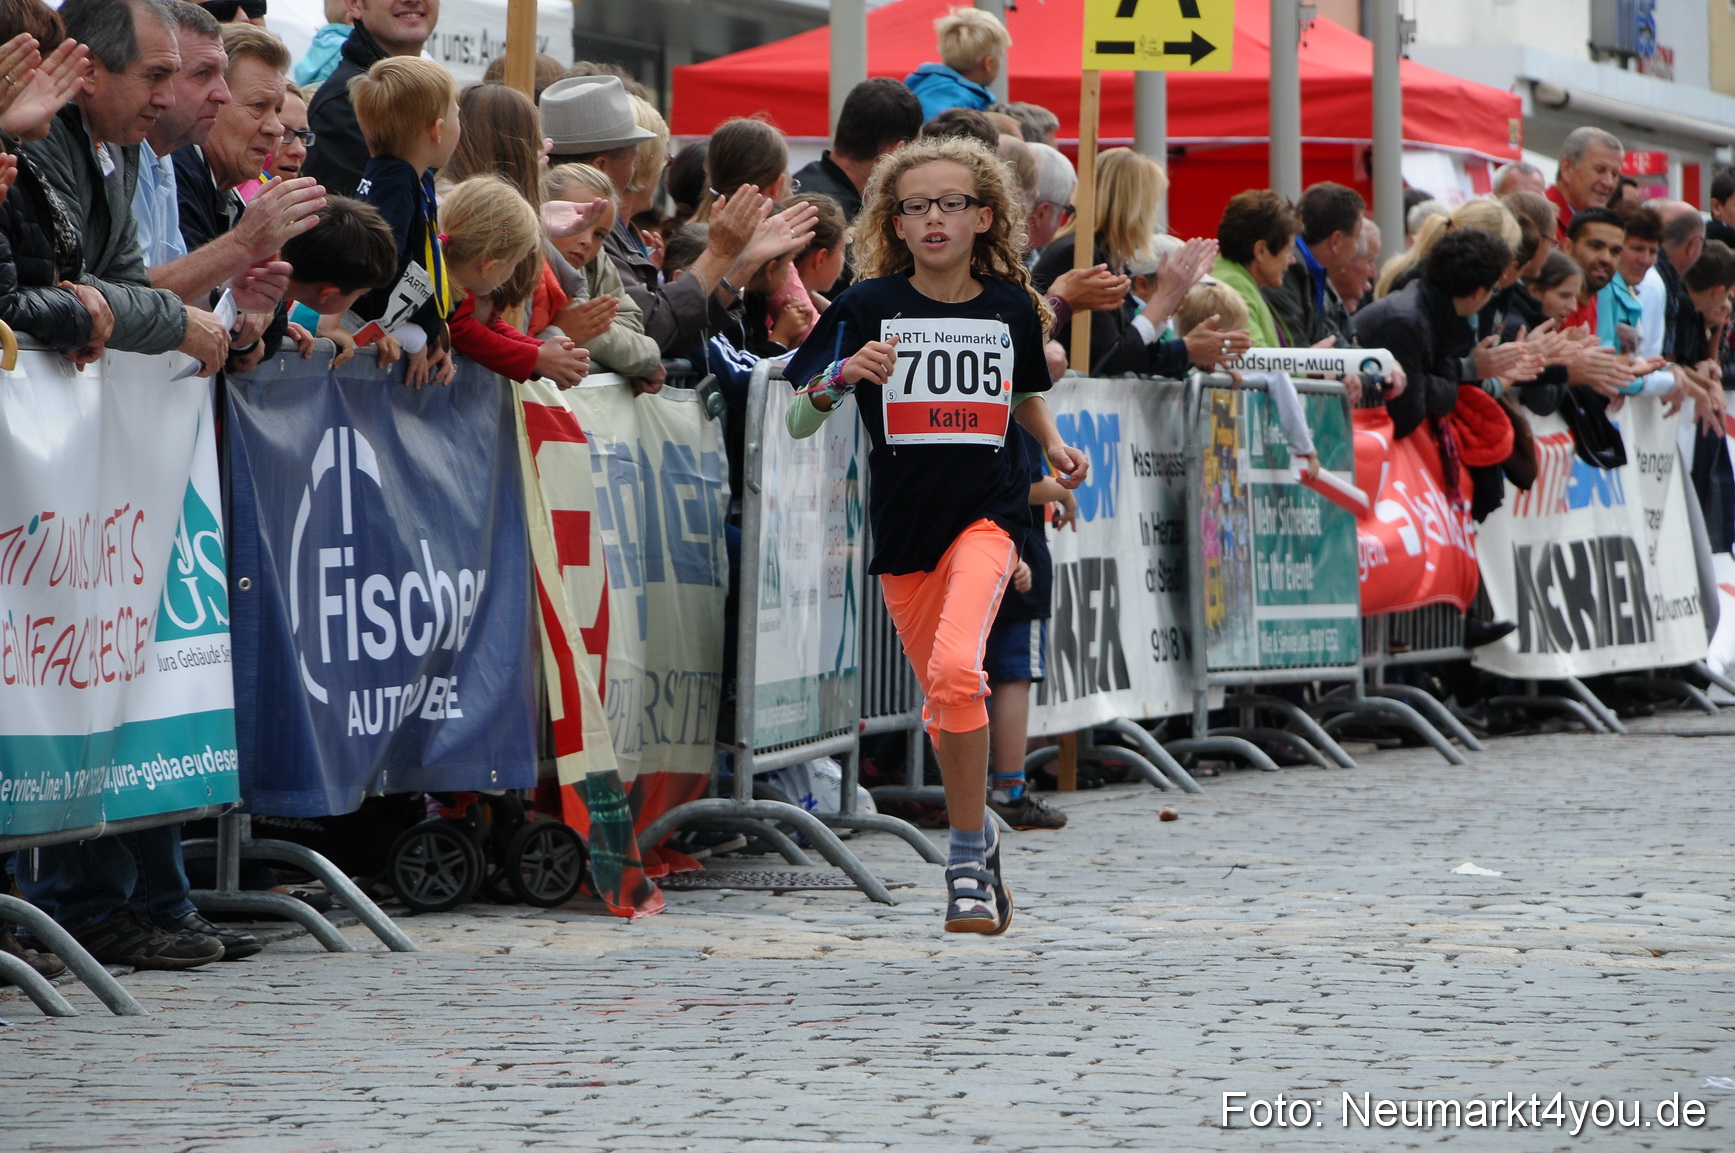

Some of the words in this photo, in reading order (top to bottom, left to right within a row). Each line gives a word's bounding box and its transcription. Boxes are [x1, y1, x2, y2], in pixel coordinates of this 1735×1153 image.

[934, 332, 997, 345] Neumarkt
[897, 349, 1001, 396] 7005
[929, 408, 978, 431] Katja
[318, 539, 487, 664] Fischer
[157, 652, 178, 673] Jura
[177, 645, 221, 669] Gebäude
